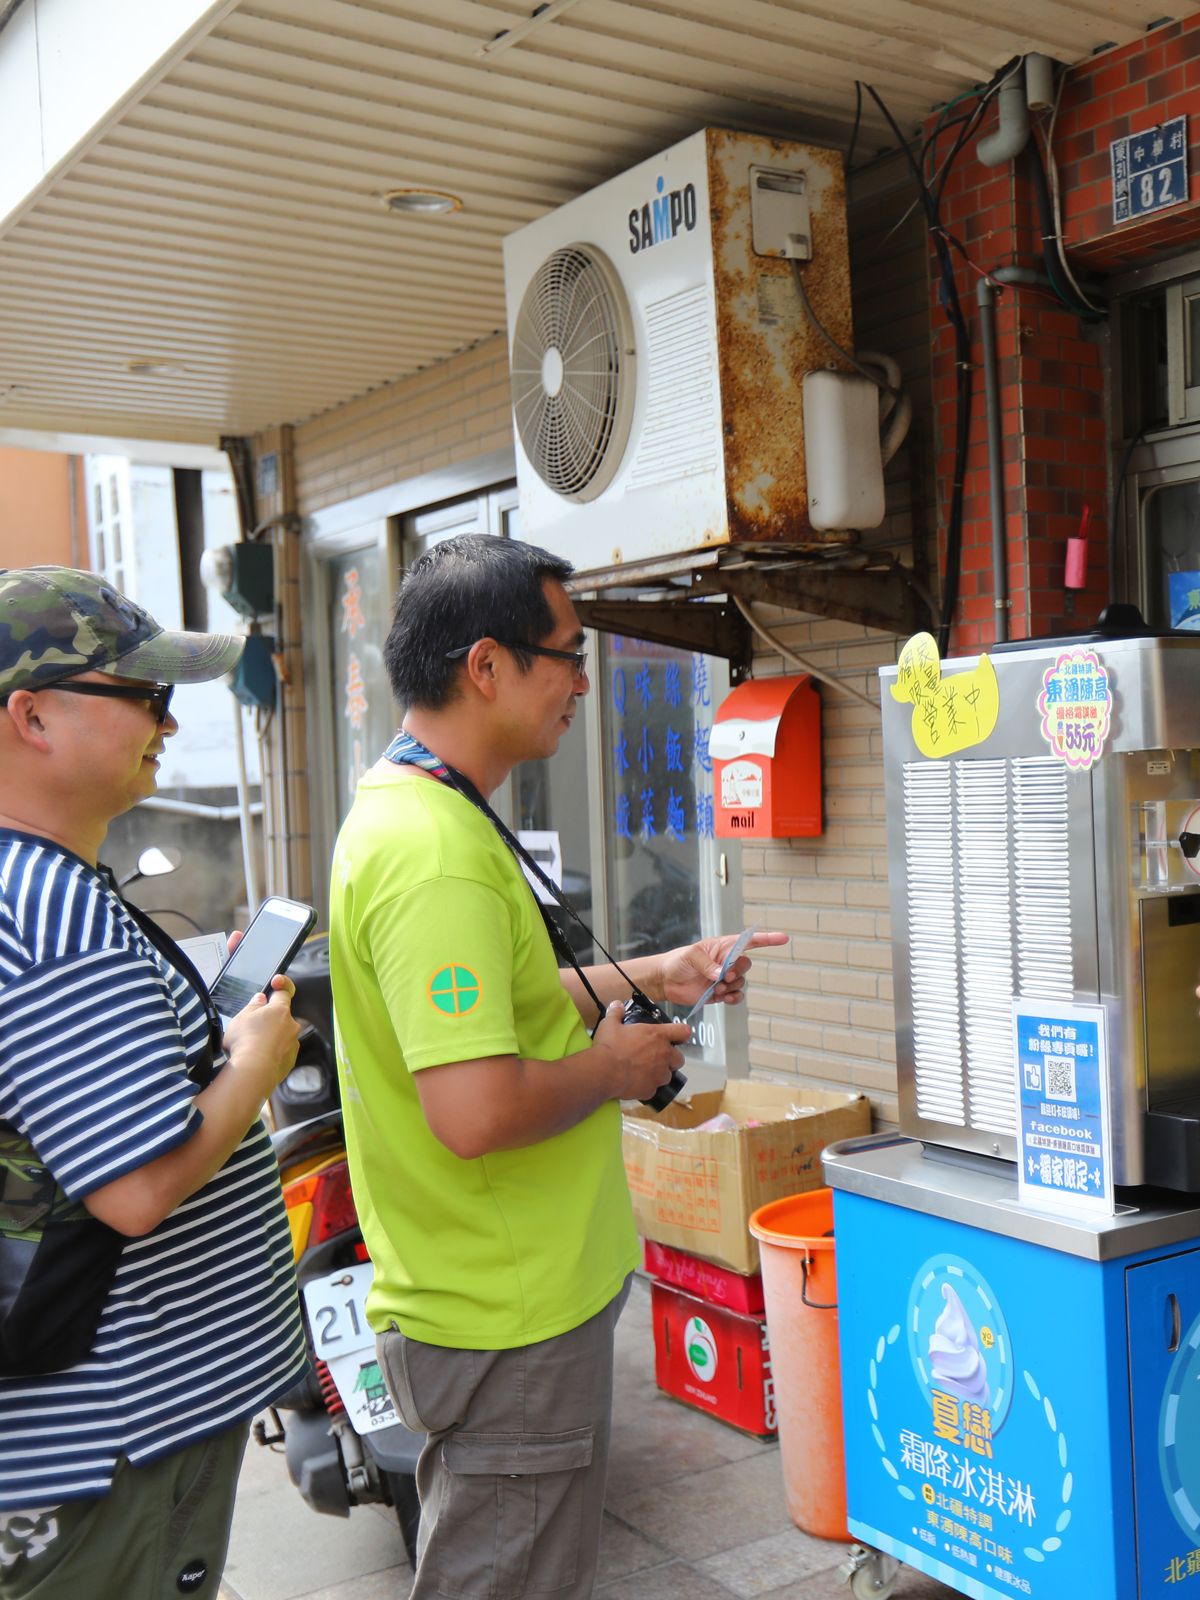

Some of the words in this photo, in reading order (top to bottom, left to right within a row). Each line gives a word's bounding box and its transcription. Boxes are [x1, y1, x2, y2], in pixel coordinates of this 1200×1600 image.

[1141, 168, 1172, 207] 82
[629, 181, 696, 254] SAMPO
[1047, 678, 1107, 703] 東湧陳高
[730, 811, 754, 829] mail
[1038, 1024, 1077, 1040] 我們有
[1030, 1120, 1093, 1140] facebook
[315, 1298, 370, 1345] 21
[931, 1388, 993, 1459] 夏戀
[899, 1428, 1036, 1528] 霜降冰淇淋
